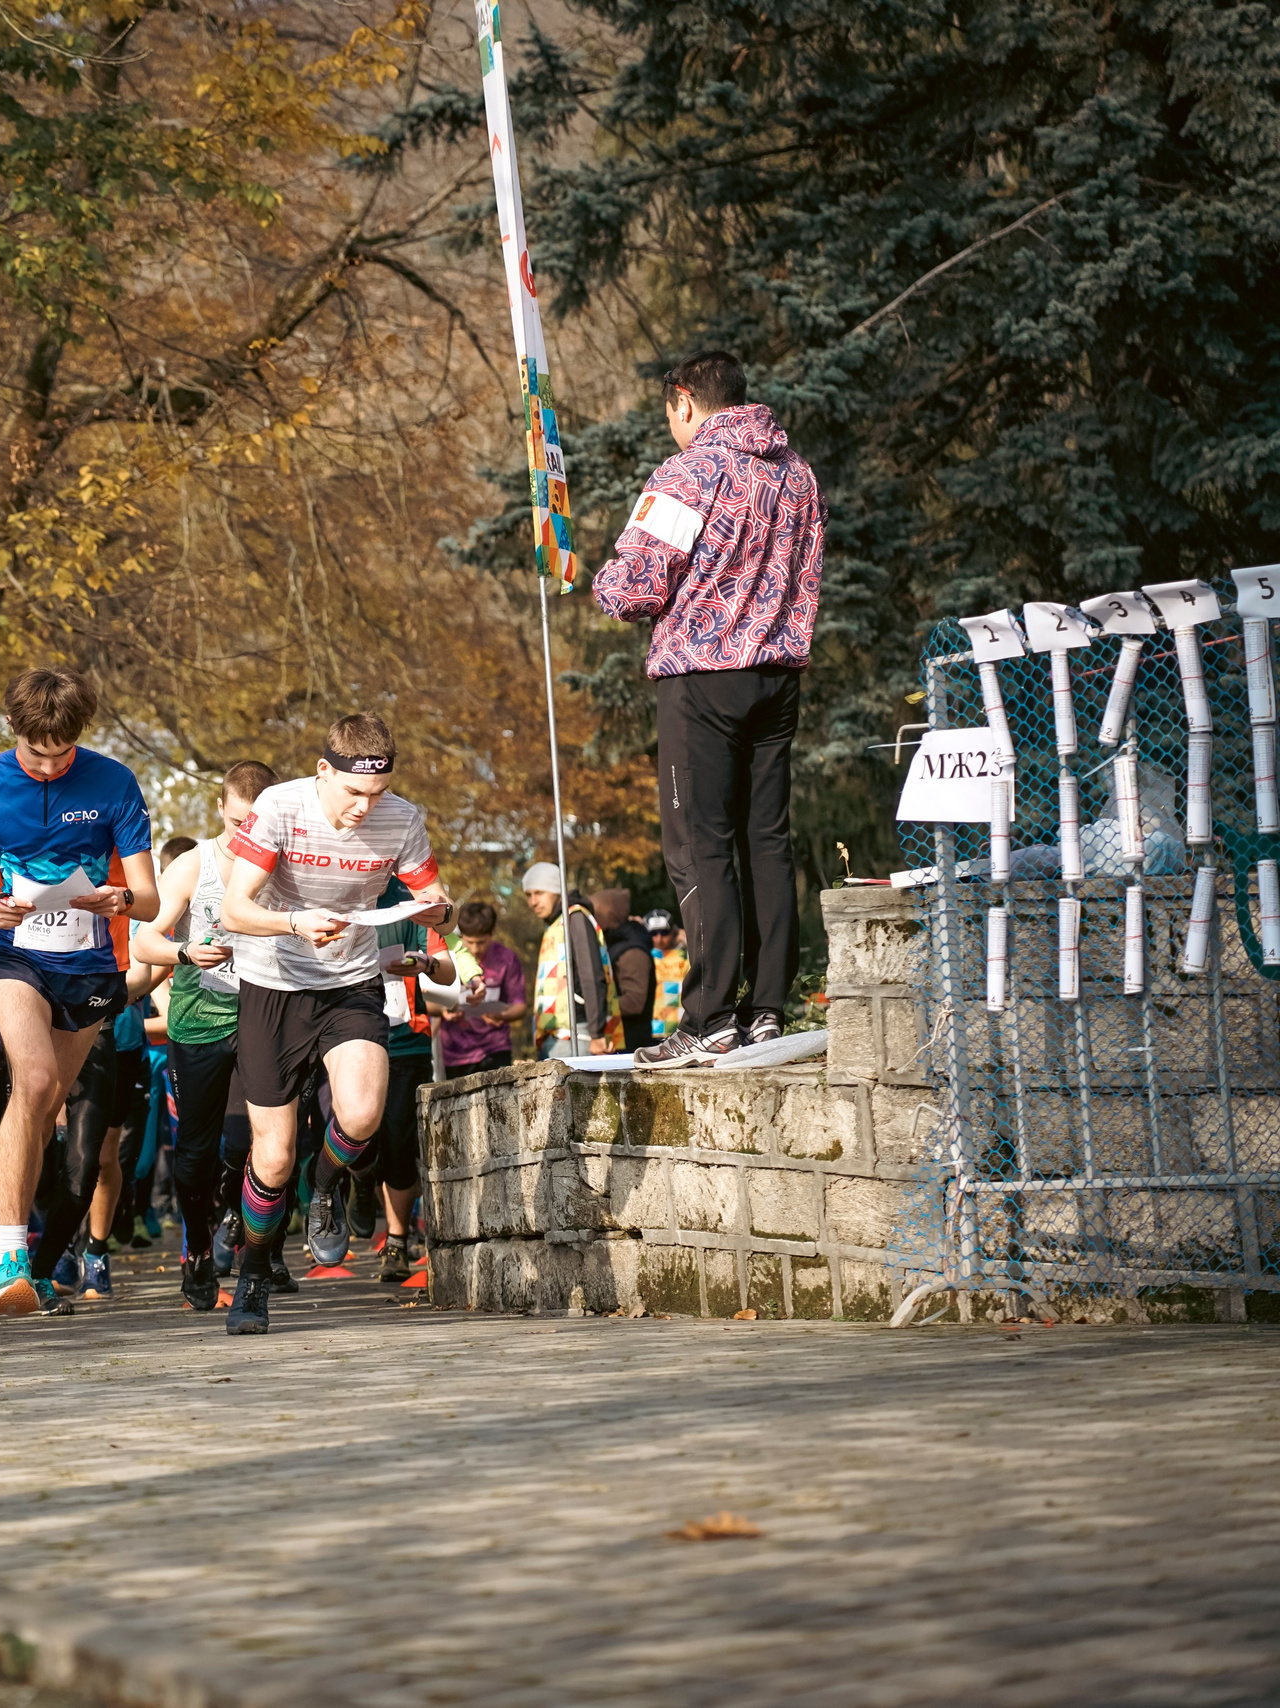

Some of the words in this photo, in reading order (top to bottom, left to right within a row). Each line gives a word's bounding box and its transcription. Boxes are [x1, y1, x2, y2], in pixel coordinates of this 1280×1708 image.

[1257, 577, 1275, 600] 5
[1179, 590, 1196, 606] 4
[1108, 601, 1128, 618] 3
[1051, 612, 1069, 632] 2
[983, 624, 999, 643] 1
[339, 858, 396, 872] WEST
[32, 911, 68, 927] 202
[75, 917, 80, 927] 1
[27, 925, 51, 935] МЖ16
